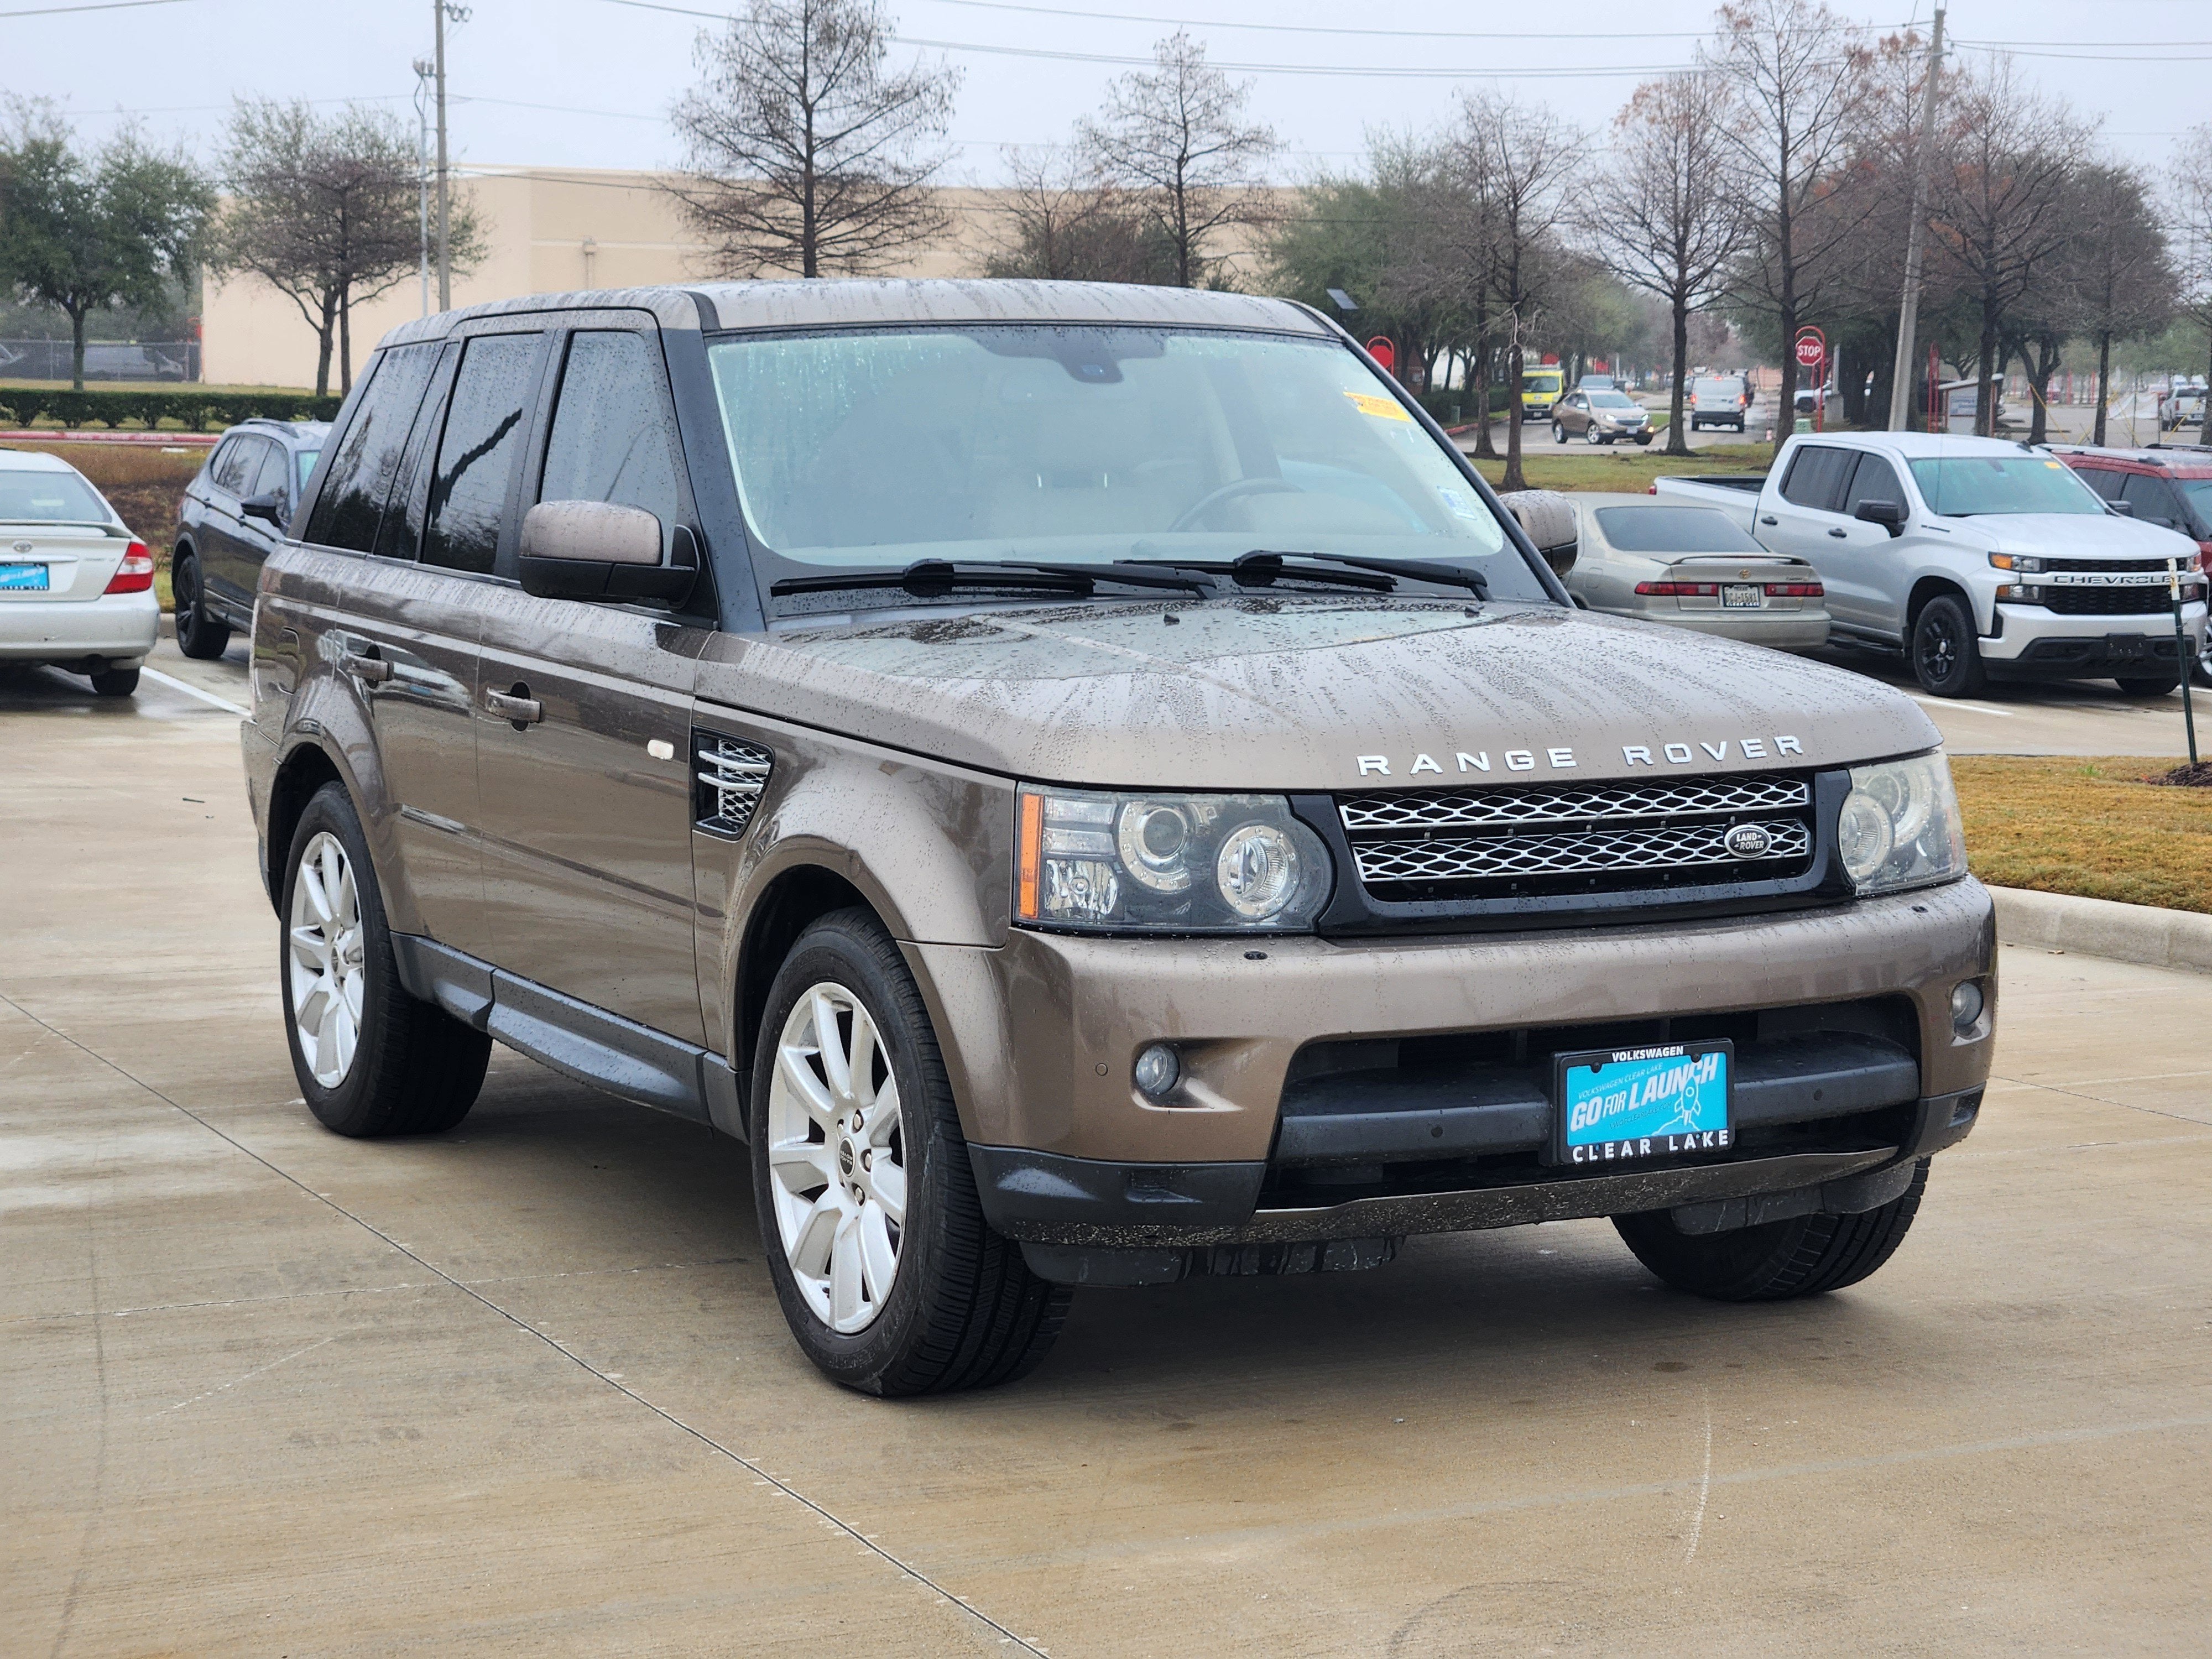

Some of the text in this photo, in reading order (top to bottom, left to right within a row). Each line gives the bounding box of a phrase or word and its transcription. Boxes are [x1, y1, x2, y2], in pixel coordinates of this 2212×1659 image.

[1797, 344, 1821, 357] STOP
[2054, 575, 2185, 585] CHEVROLET
[1357, 735, 1804, 776] RANGE ROVER
[1736, 832, 1757, 842] LAND
[1739, 841, 1765, 850] ROVER
[1611, 1045, 1684, 1062] VOLKSWAGEN
[1578, 1062, 1663, 1099] VOLKSWAGEN CLEAR LAKE
[1570, 1052, 1719, 1132] GO FOR LAUNCH
[1572, 1129, 1729, 1162] CLEAR LAKE
